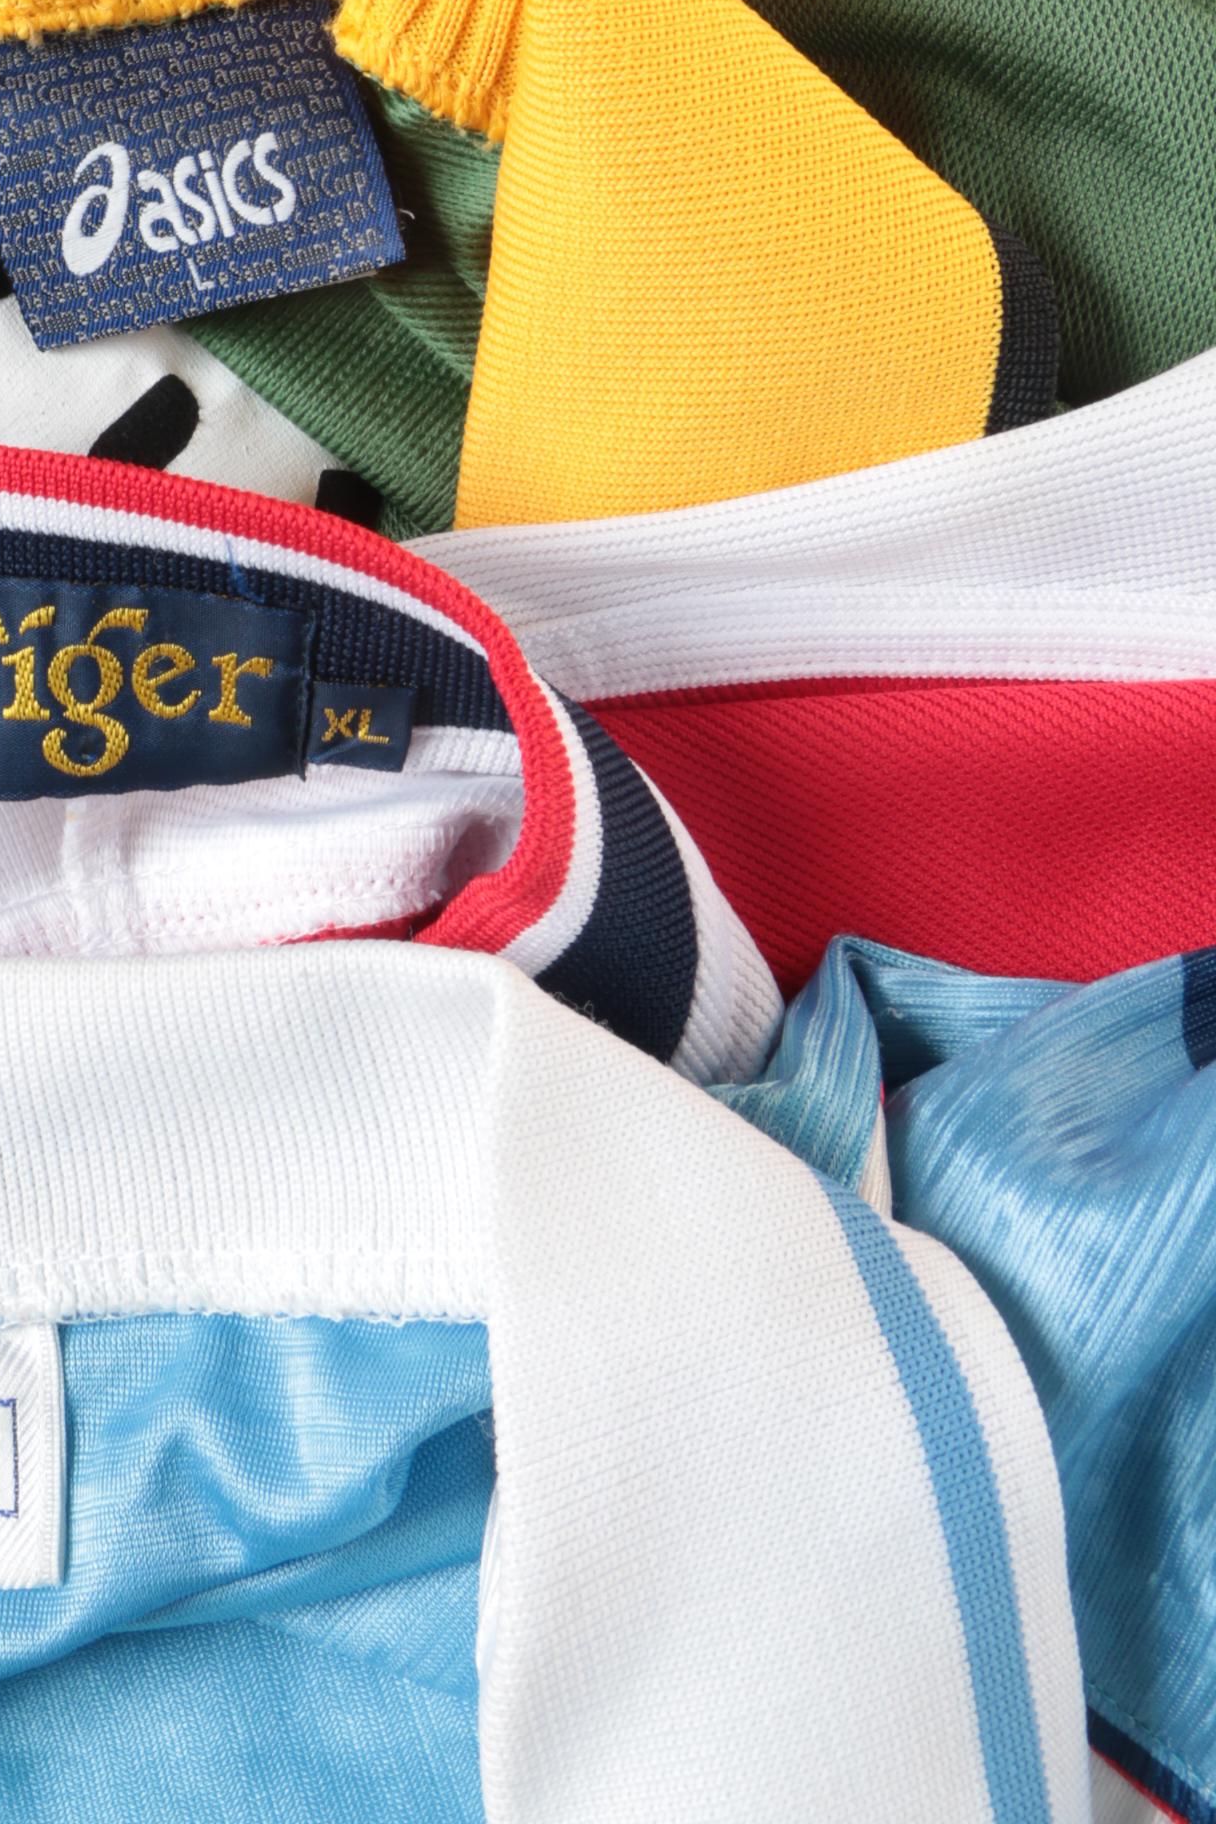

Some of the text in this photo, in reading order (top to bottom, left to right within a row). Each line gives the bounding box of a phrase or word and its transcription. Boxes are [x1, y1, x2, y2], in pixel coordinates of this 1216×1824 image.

[139, 133, 295, 253] asics
[186, 258, 215, 291] L
[321, 708, 390, 744] XL
